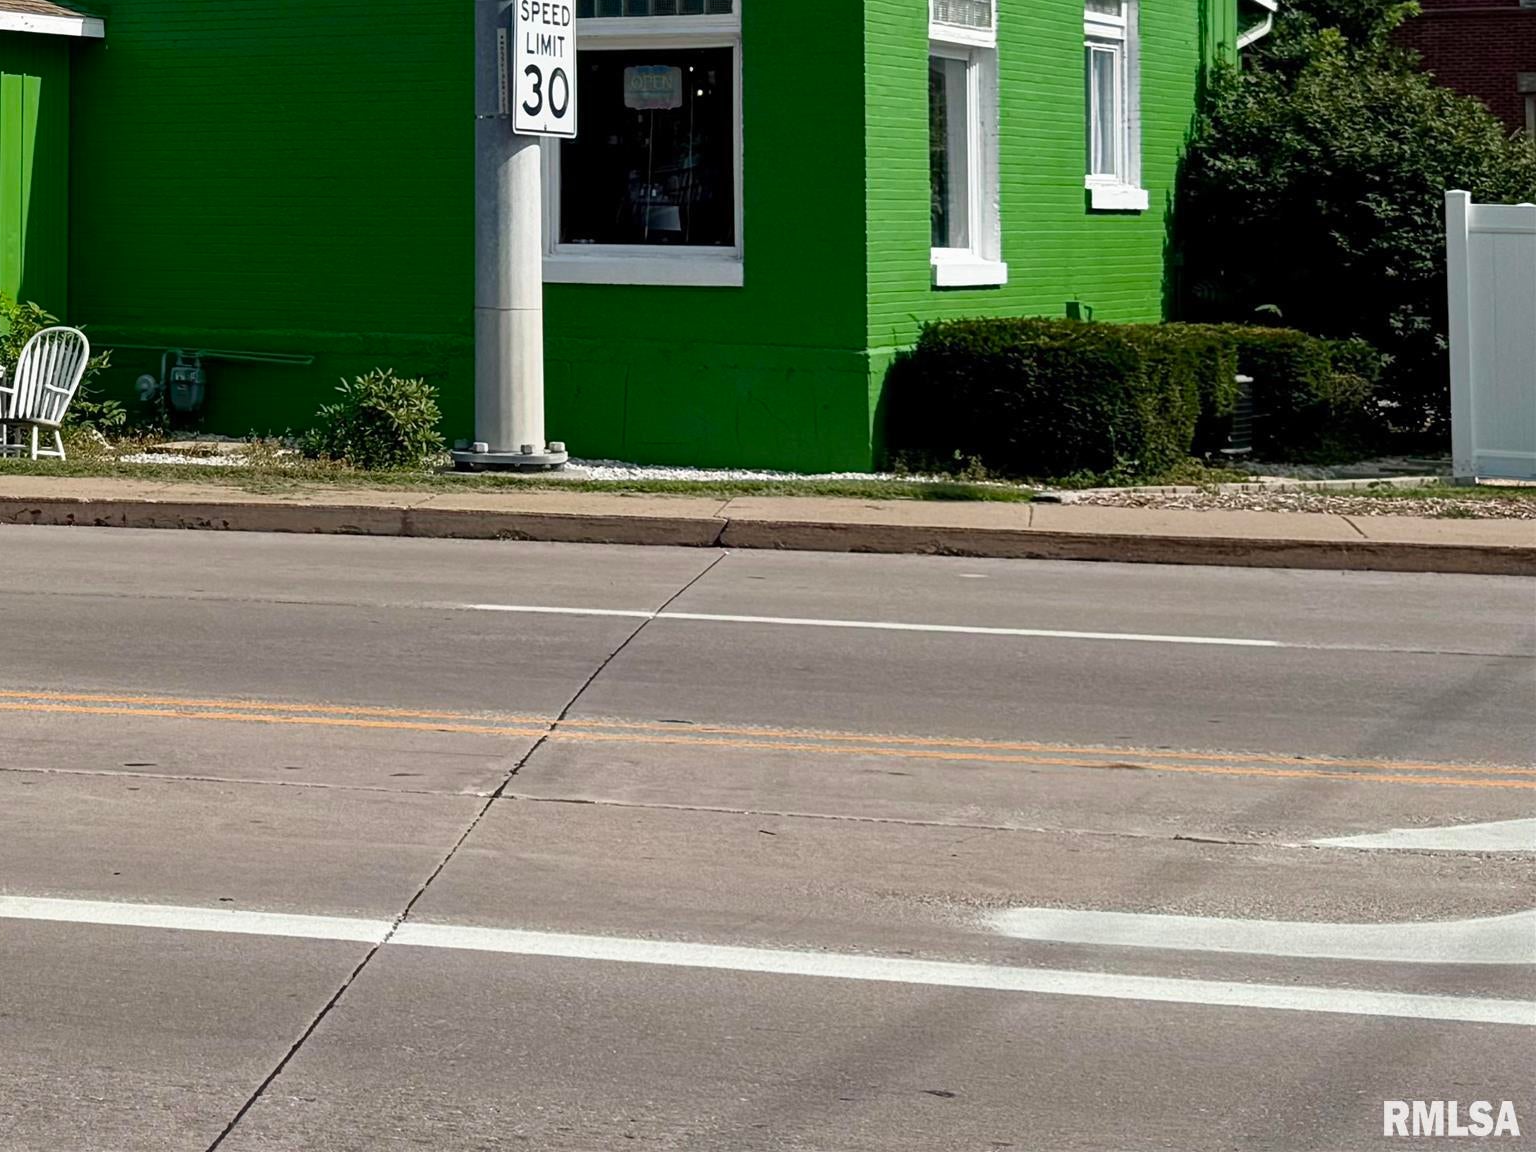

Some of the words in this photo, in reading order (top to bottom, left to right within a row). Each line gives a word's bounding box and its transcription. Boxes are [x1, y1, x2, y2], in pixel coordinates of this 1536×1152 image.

[521, 0, 571, 27] SPEED
[526, 32, 565, 58] LIMIT
[522, 64, 570, 119] 30
